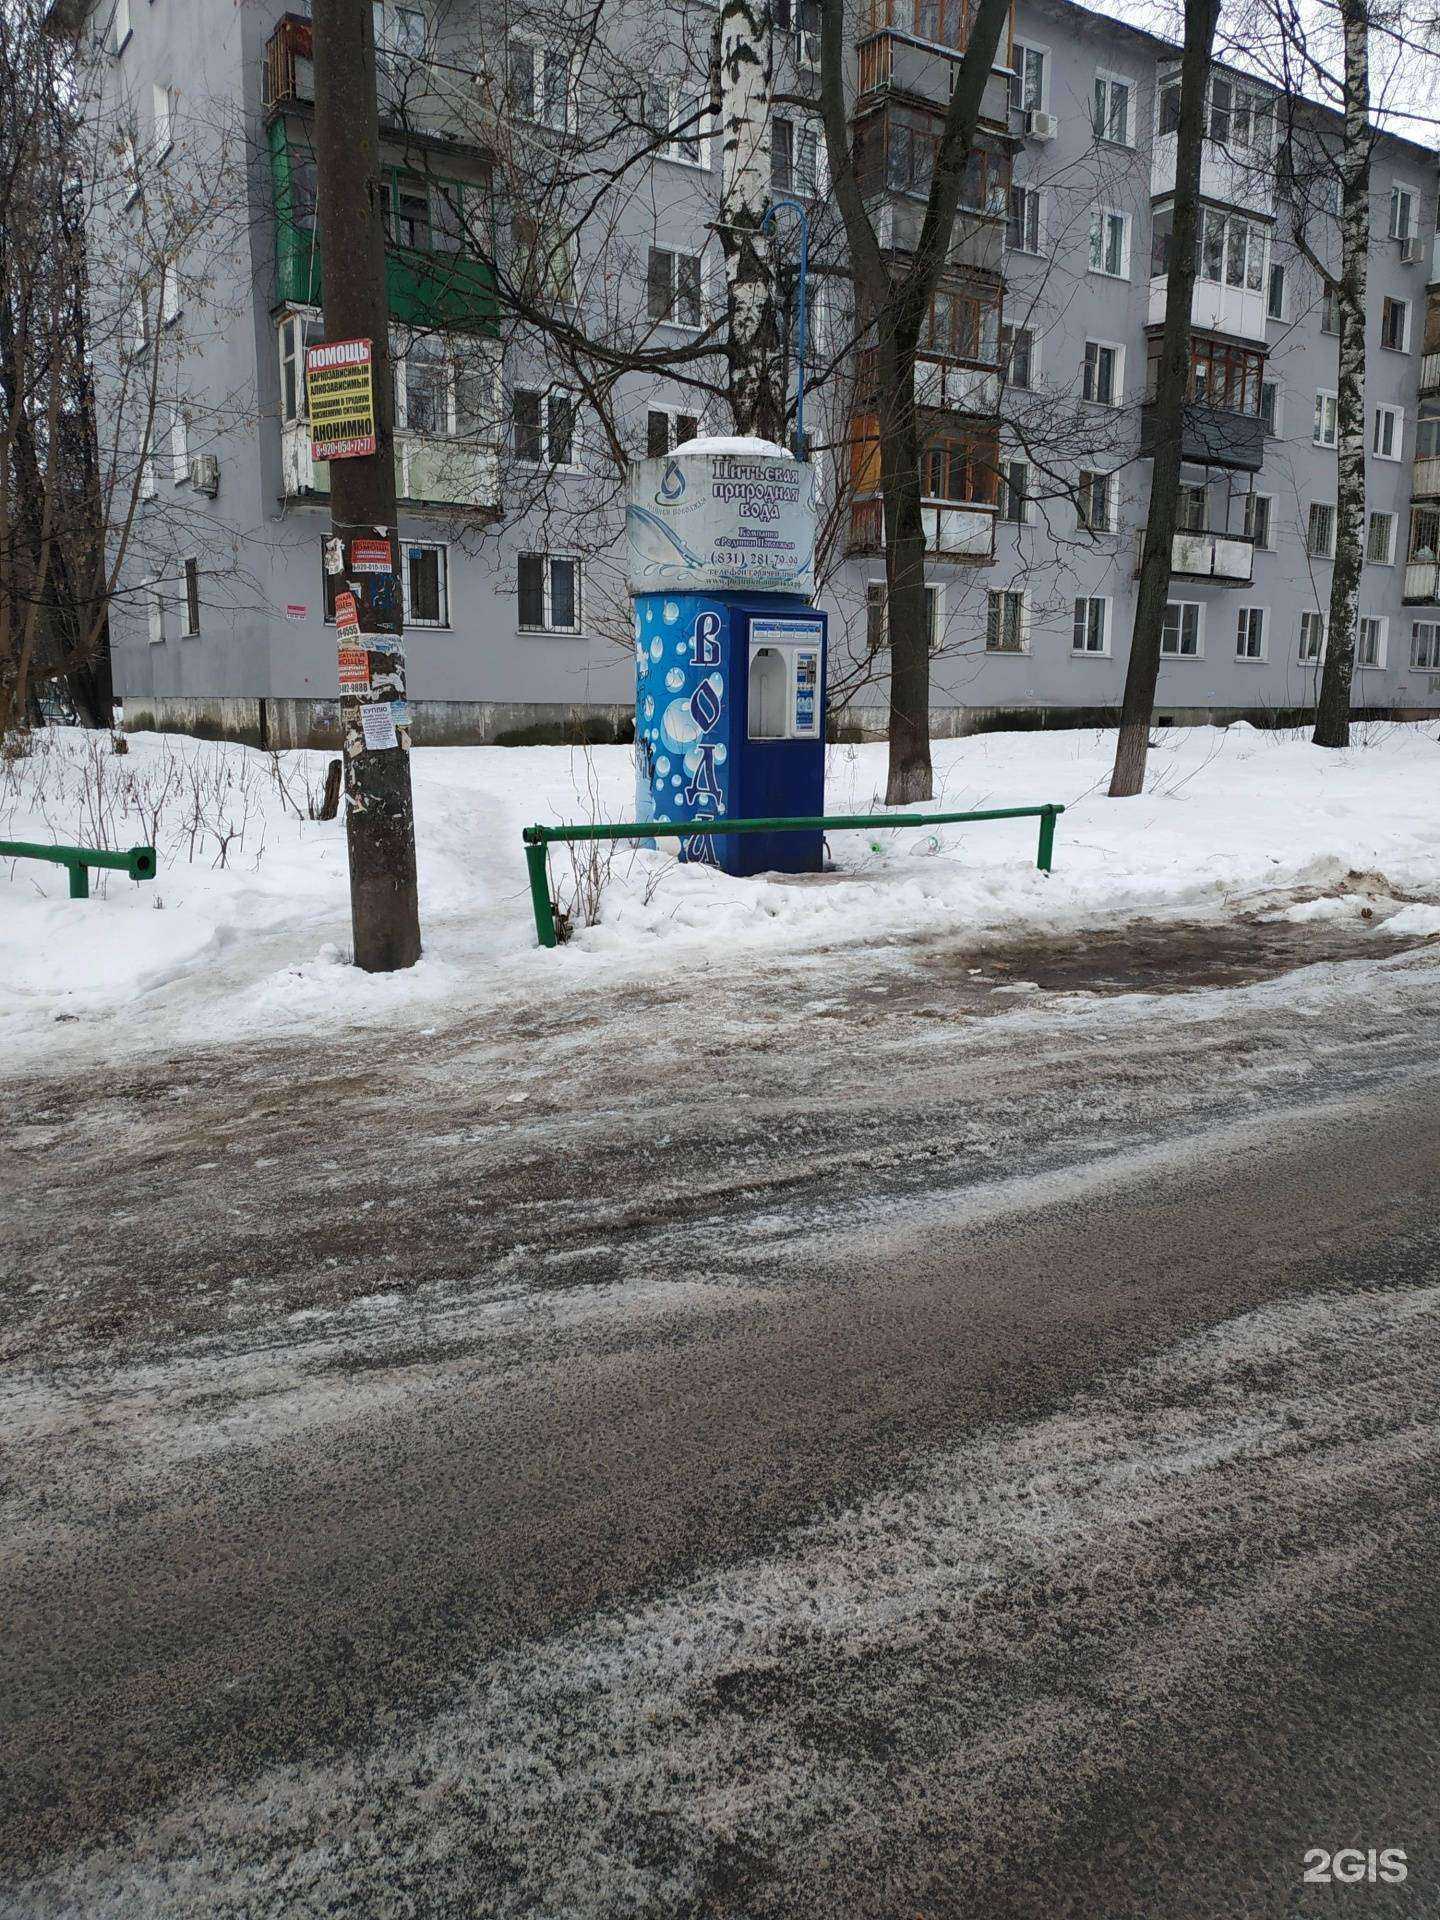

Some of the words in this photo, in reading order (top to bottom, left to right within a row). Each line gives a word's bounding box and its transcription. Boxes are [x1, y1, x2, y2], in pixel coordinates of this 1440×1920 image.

[309, 342, 369, 368] ПОМОЩЬ
[313, 418, 372, 443] АНОНИМНО
[712, 458, 800, 483] Питьевая
[712, 482, 800, 504] природная
[738, 502, 781, 523] вода
[711, 550, 745, 566] (831)
